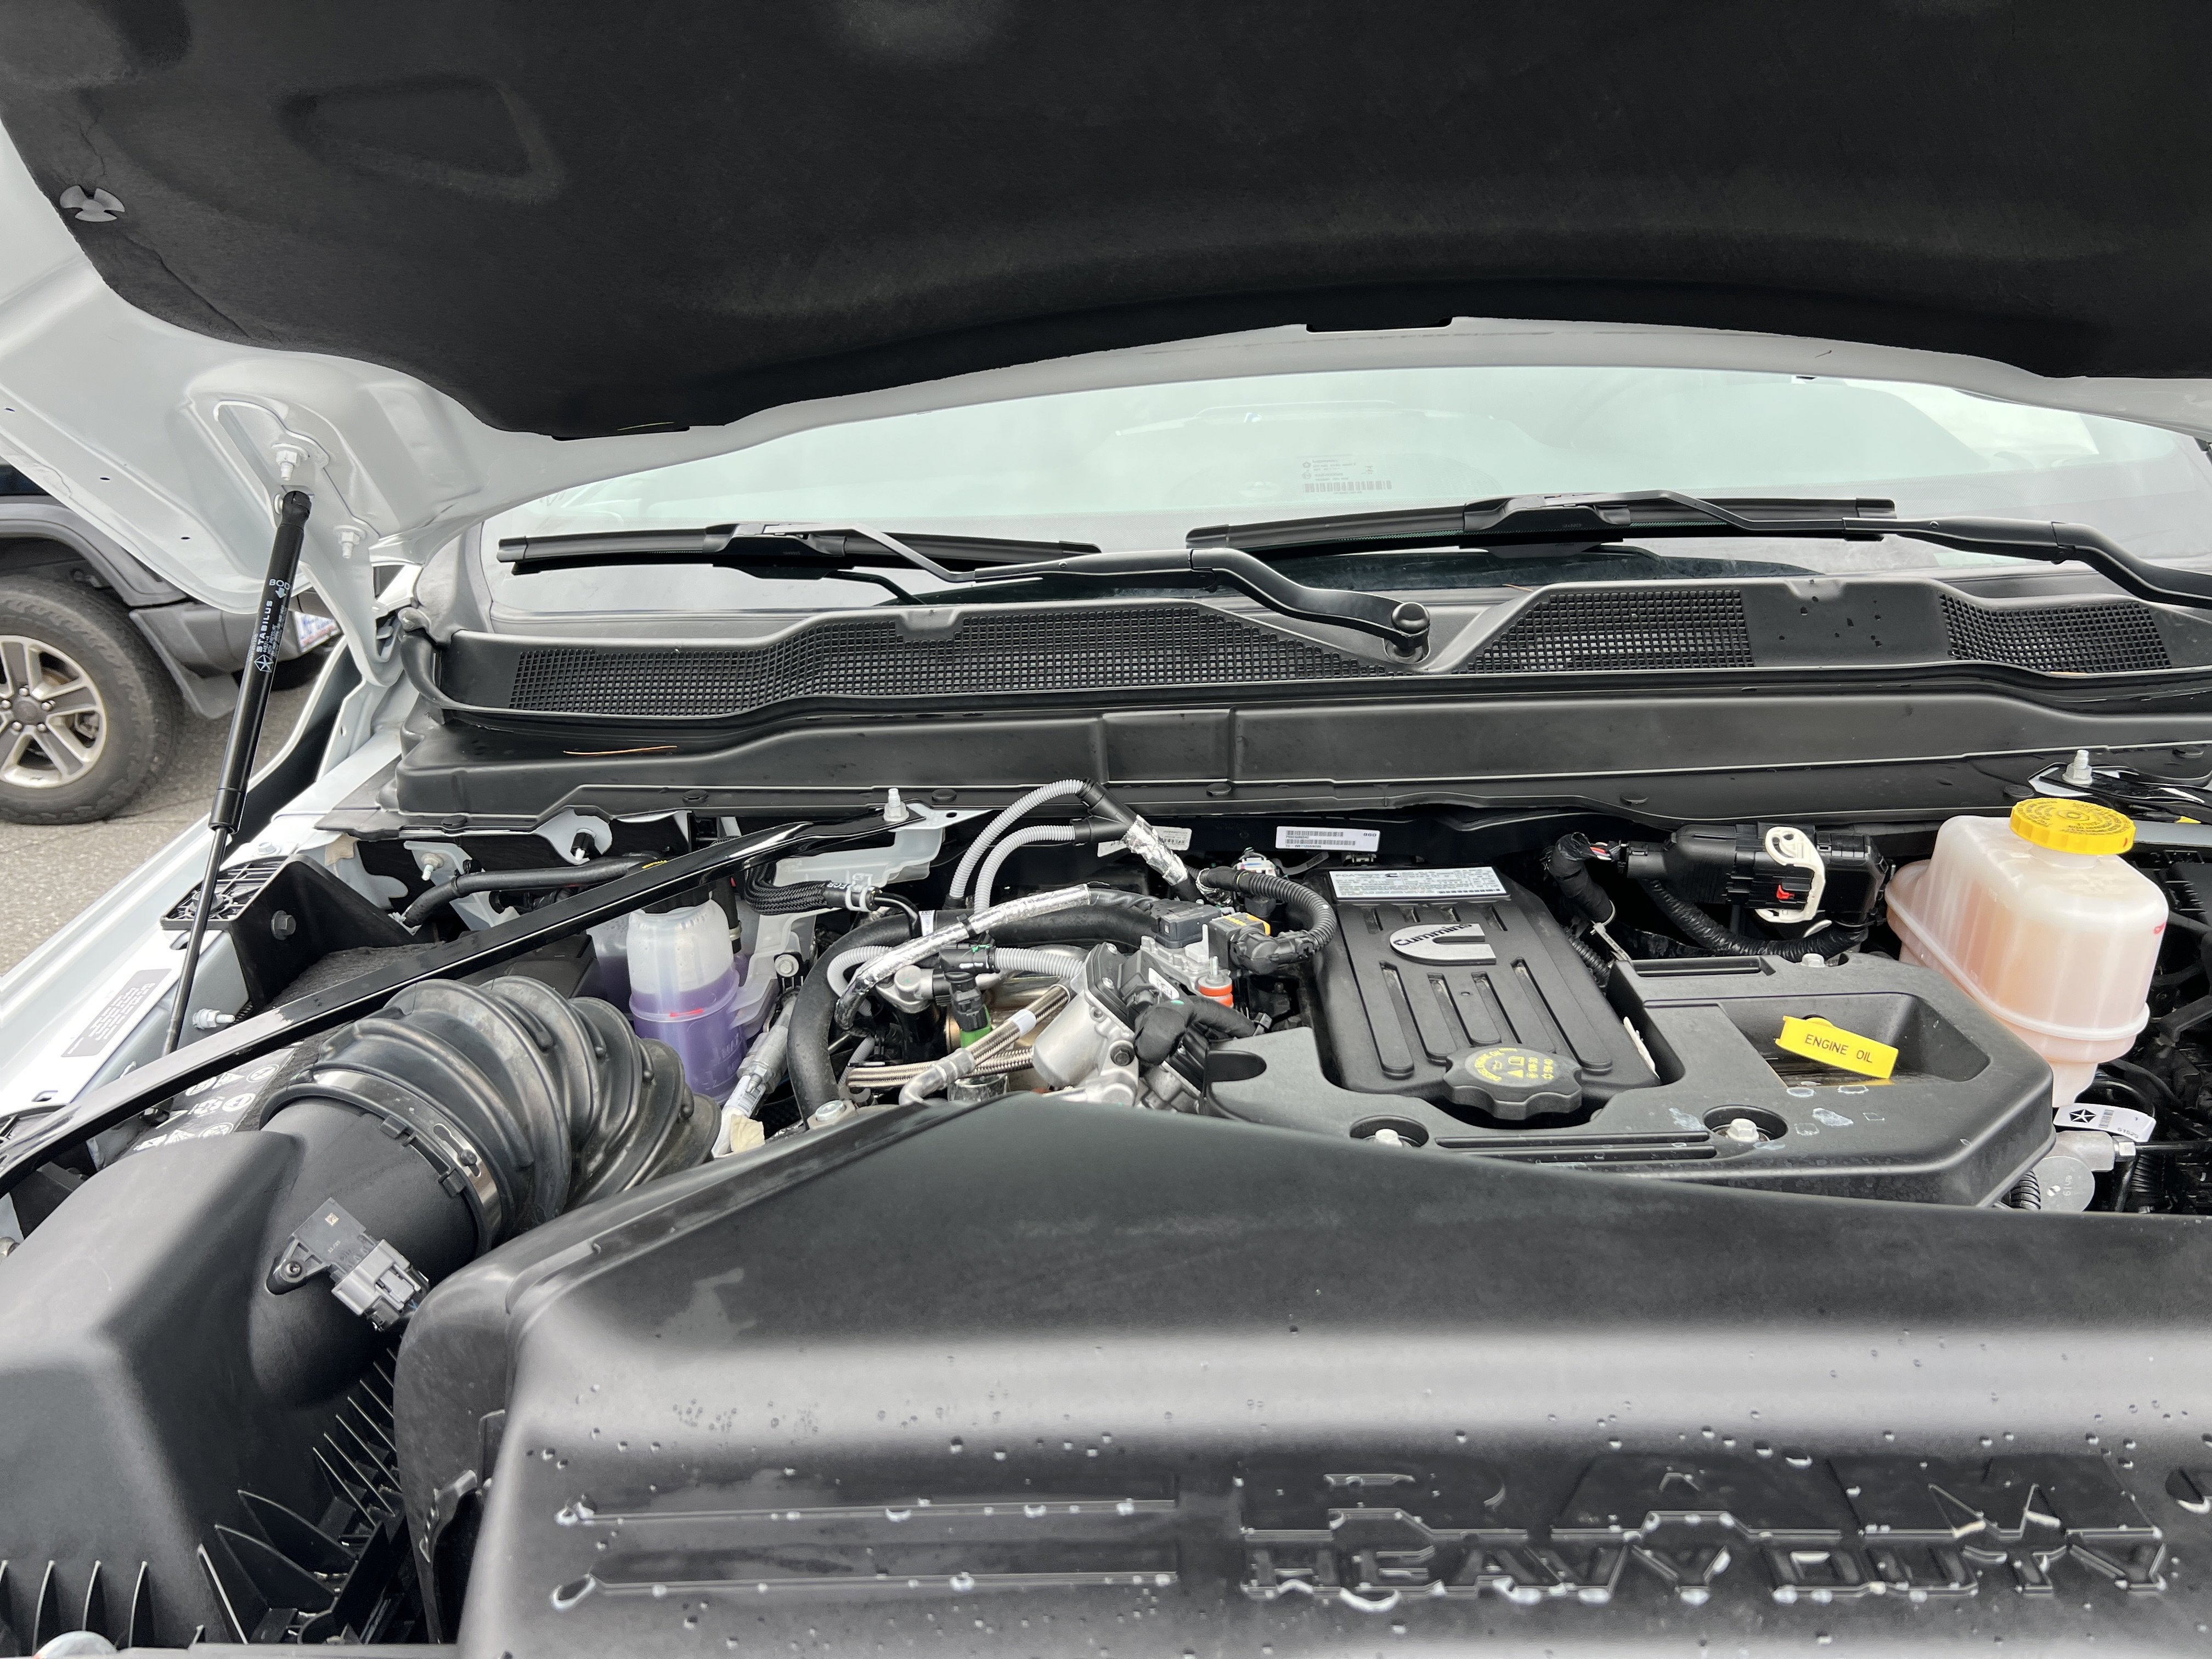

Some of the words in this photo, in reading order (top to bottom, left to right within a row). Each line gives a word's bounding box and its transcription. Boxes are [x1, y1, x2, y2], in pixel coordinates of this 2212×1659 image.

[256, 600, 273, 653] STABILUS
[1393, 923, 1472, 946] Cummins
[1805, 1034, 1849, 1056] ENGINE
[1857, 1049, 1873, 1063] OIL
[1241, 1455, 2162, 1539] RAM
[1241, 1543, 1731, 1599] HEAVY
[1762, 1543, 2167, 1596] DUTY
